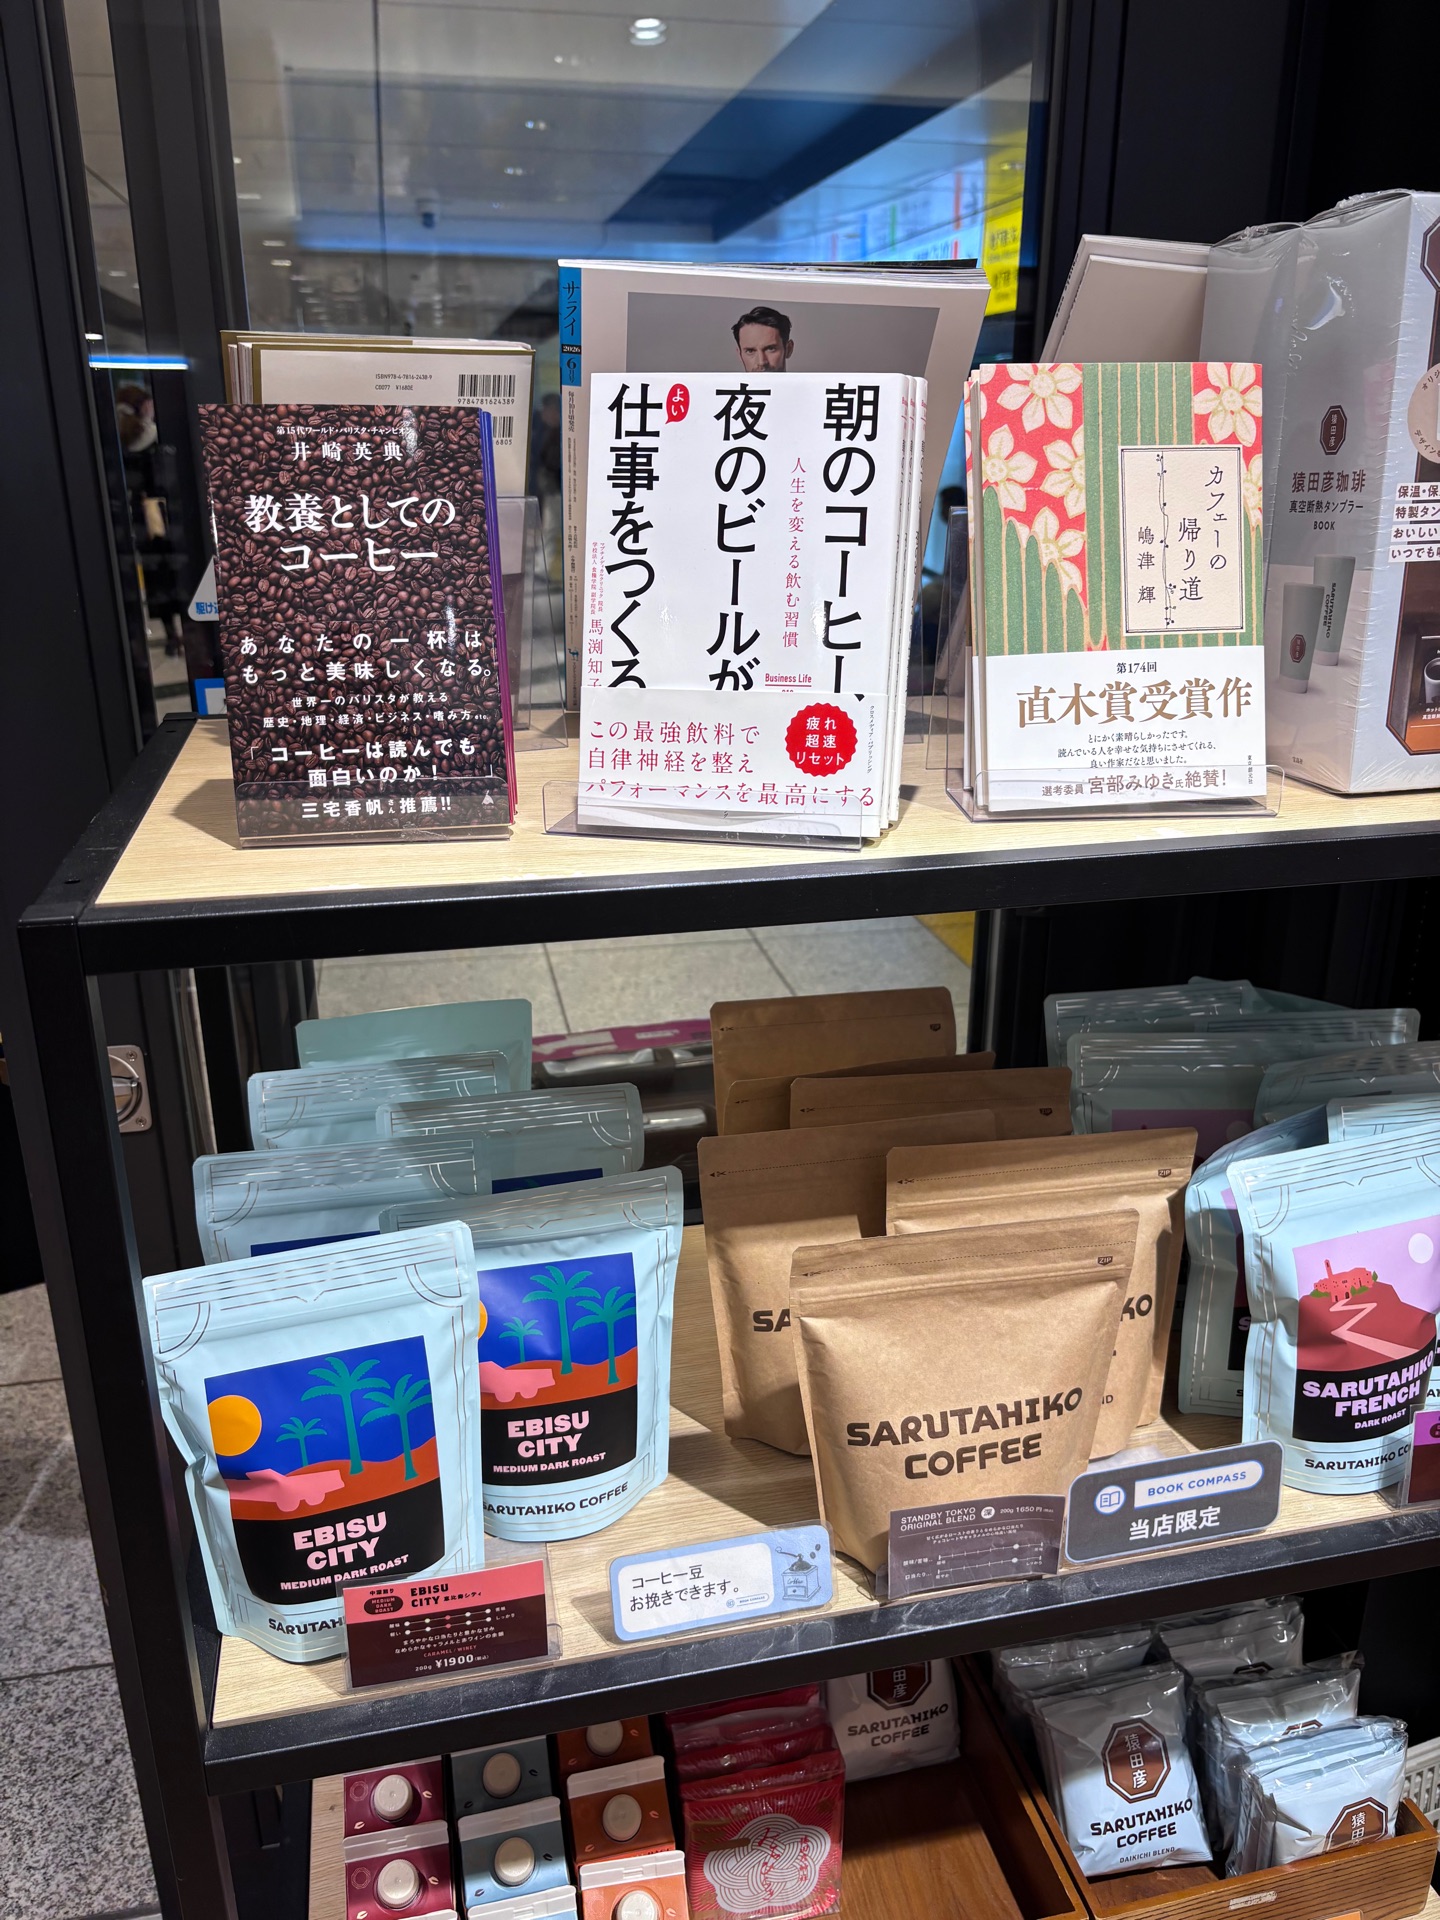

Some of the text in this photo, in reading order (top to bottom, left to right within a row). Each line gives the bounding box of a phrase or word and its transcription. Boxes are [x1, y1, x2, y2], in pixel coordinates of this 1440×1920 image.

[562, 281, 580, 337] サライ
[563, 345, 580, 353] 2026
[375, 373, 433, 381] ISBN978-4-7816-2438-9
[671, 387, 685, 417] よい
[291, 441, 403, 462] 井崎英典
[1291, 469, 1366, 493] 猿田彦珈琲
[1397, 484, 1440, 498] 保温・保
[244, 494, 456, 534] 教養としての
[1204, 464, 1228, 571] カフェーの
[1289, 499, 1364, 514] 真空断熱タンブラー
[706, 383, 772, 691] 夜のビールが
[1313, 520, 1335, 531] BOOK
[1393, 526, 1438, 539] おいしい
[279, 537, 440, 573] コーヒー
[781, 456, 807, 648] 人生を変える飲む習慣
[1178, 517, 1203, 602] 帰り道
[1137, 526, 1156, 604] 嶋津輝
[240, 631, 482, 657] あなたの一杯は
[242, 660, 492, 685] もっと美味しくなる。
[765, 673, 812, 683] Business Life
[1116, 661, 1157, 674] 第174回
[291, 692, 449, 708] 世界一のバリスタが教える
[1016, 676, 1253, 728] 直木賞受賞作
[589, 719, 760, 747] この最強飲料で
[806, 716, 837, 730] 疲れ
[805, 734, 837, 749] 超速
[1057, 741, 1217, 758] 読んでいる人を幸せな気持ちにさせてくれる、
[1088, 730, 1188, 744] とにかく素晴らしかったです。
[587, 747, 755, 775] 自律神経を整え
[795, 752, 844, 766] リセット
[1089, 755, 1188, 769] 良い作家だなと思いました。
[586, 778, 874, 808] パフォーマンスを最高にする
[1041, 785, 1085, 797] 選考委員
[1159, 1169, 1171, 1177] ZIP
[1100, 1256, 1111, 1264] ZIP
[1302, 1350, 1434, 1398] SARUTAHIKO
[1334, 1379, 1421, 1417] FRENCH
[507, 1410, 590, 1438] EBISU
[847, 1386, 1083, 1447] SARUTAHIKO
[1354, 1408, 1407, 1430] DARK ROAST
[517, 1433, 583, 1458] CITY
[904, 1432, 1042, 1480] COFFEE
[493, 1451, 606, 1473] MEDIUM DARK ROAST
[1304, 1451, 1396, 1471] SARUTAHIKO
[579, 1481, 629, 1510] COFFEE
[1147, 1471, 1247, 1497] BOOK COMPASS
[900, 1506, 976, 1524] STANDBY TOKYO
[900, 1513, 976, 1532] ORIGINAL BLEND
[1128, 1505, 1221, 1541] 当店限定
[293, 1511, 387, 1550] EBISU
[306, 1536, 380, 1571] CITY
[280, 1554, 409, 1591] MEDIUM DARK ROAST
[632, 1564, 704, 1590] コーヒー豆
[410, 1583, 449, 1597] EBISU
[411, 1595, 440, 1608] CITY
[629, 1578, 740, 1612] お挽きできます。
[415, 1664, 432, 1672] 200g
[435, 1654, 474, 1669] ¥1900
[423, 1648, 453, 1658] CARAMEL
[847, 1703, 949, 1737] SARUTAHIKO
[871, 1723, 930, 1747] COFFEE
[1125, 1733, 1148, 1789] 猿田彦
[1090, 1798, 1193, 1837] SARUTAHIKO
[1351, 1811, 1367, 1843] 猿田
[1116, 1821, 1177, 1849] COFFEE
[1119, 1846, 1175, 1864] DAIKICHI BLEND
